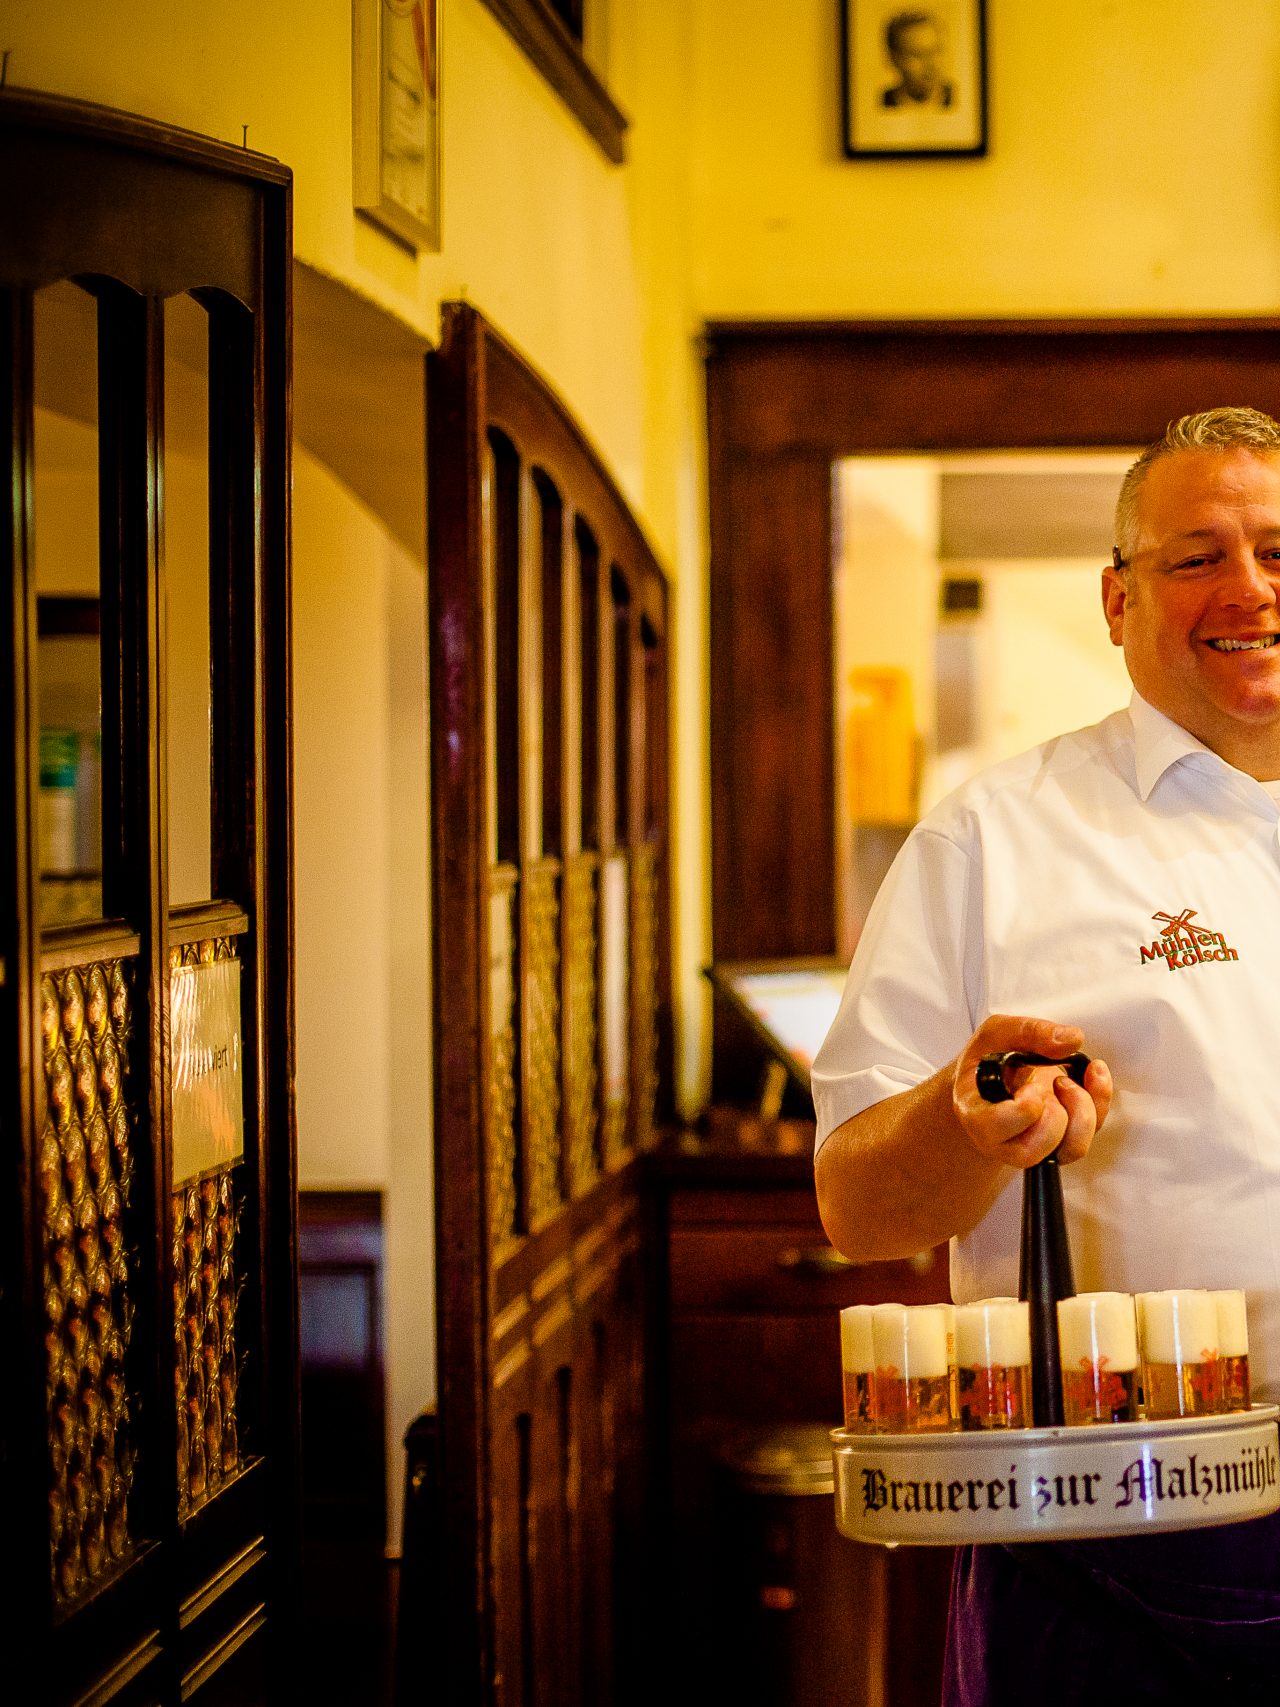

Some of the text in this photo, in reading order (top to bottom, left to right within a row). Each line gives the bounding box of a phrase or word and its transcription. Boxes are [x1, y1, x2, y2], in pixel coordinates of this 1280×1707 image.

[1140, 931, 1226, 965] Mühlen
[1165, 942, 1239, 971] Kölsch
[861, 1445, 1276, 1517] Brauerei zur Malzmühle
